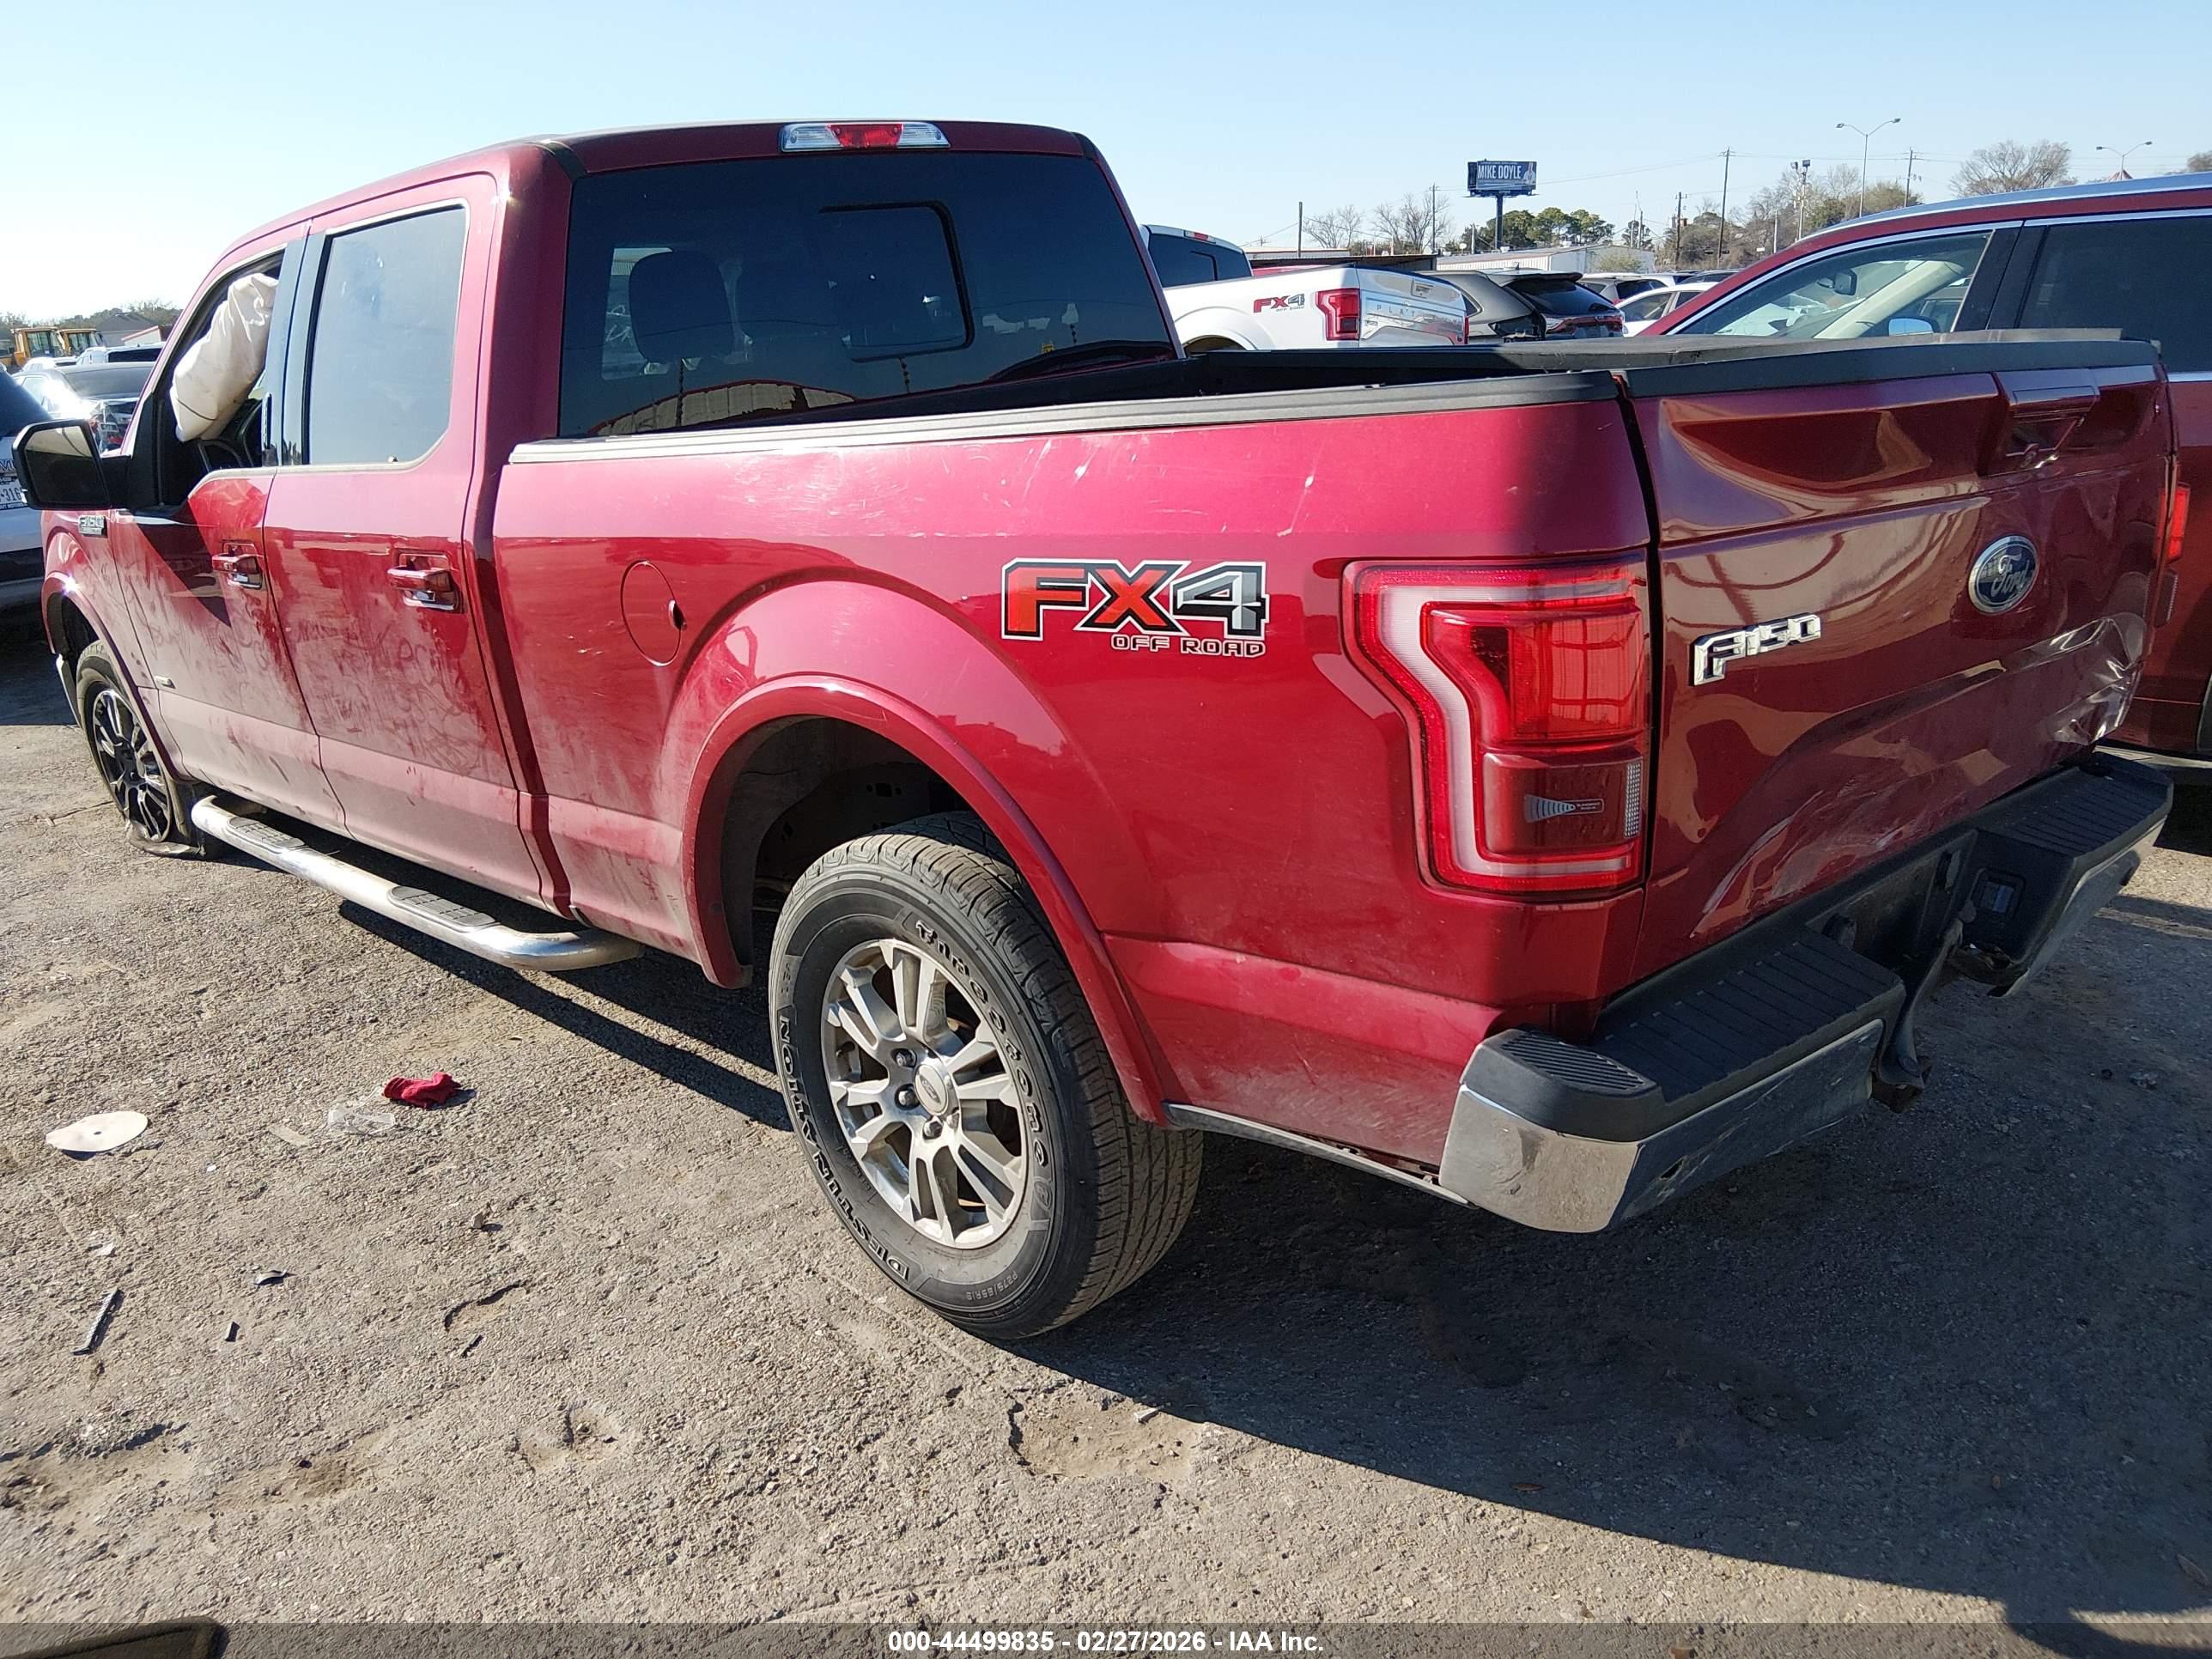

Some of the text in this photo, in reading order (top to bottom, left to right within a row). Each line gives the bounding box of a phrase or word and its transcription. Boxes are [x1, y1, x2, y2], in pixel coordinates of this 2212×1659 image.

[1477, 165, 1522, 179] MIKE DOYLE
[1253, 293, 1305, 313] FX4
[1001, 557, 1270, 641] FX4
[1110, 634, 1266, 658] OFF ROAD
[915, 919, 1048, 1168] Firestone
[779, 1015, 911, 1282] DESTINATION
